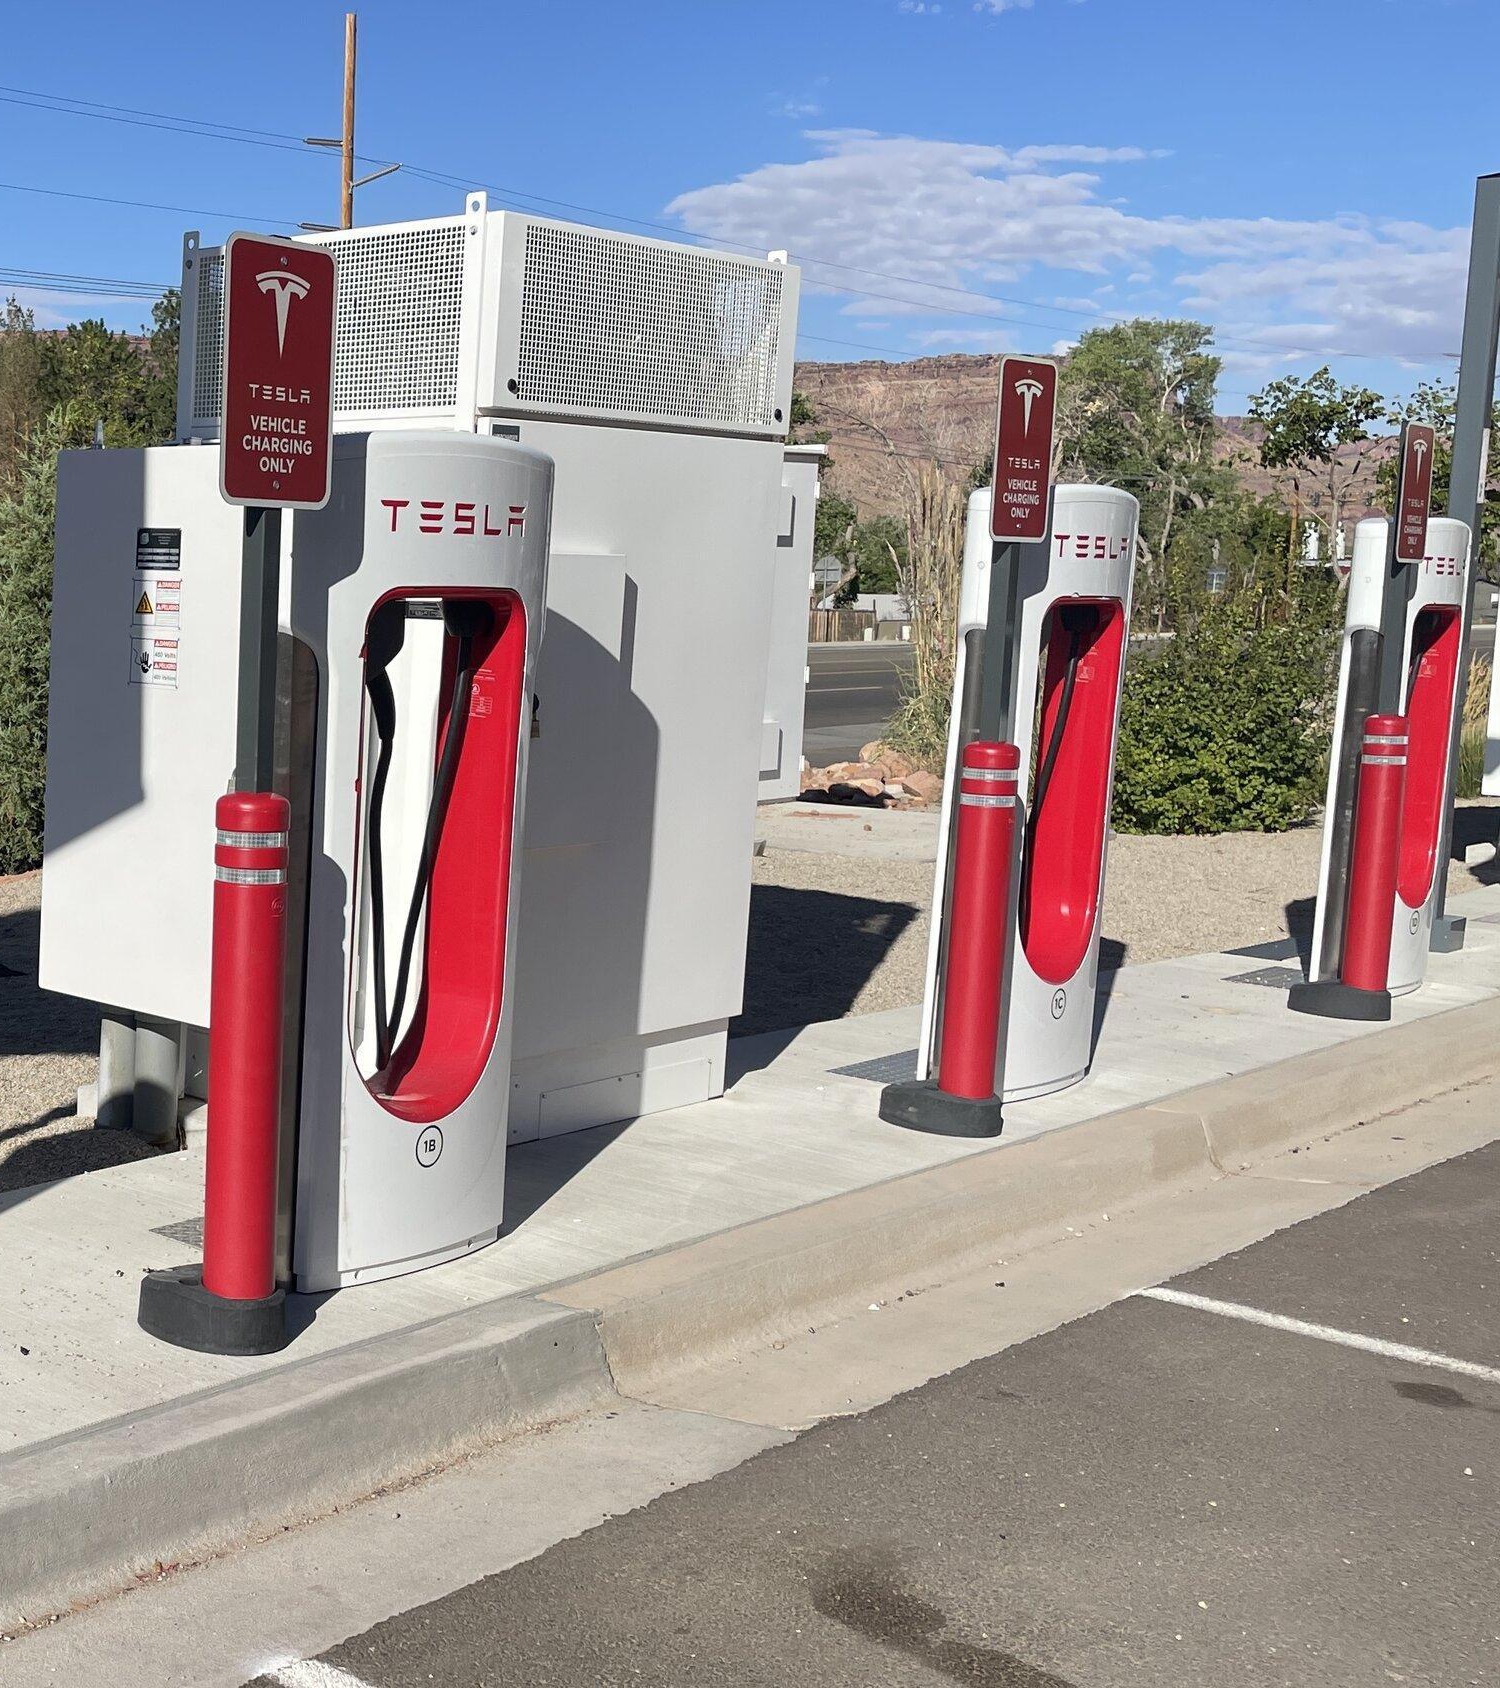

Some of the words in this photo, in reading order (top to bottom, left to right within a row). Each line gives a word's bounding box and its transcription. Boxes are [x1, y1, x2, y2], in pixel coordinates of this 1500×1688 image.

[248, 383, 310, 404] TESLA
[250, 414, 307, 435] VEHICLE
[242, 434, 312, 455] CHARGING
[259, 456, 295, 474] ONLY
[1008, 457, 1041, 469] TESLA
[1007, 478, 1038, 491] VEHICLE
[1002, 492, 1040, 505] CHARGING
[380, 499, 527, 538] TESLA
[1010, 507, 1030, 519] ONLY
[1054, 534, 1129, 560] TESLA
[1424, 556, 1465, 576] TESL
[1054, 997, 1064, 1010] 1C
[423, 1139, 436, 1153] 1B
